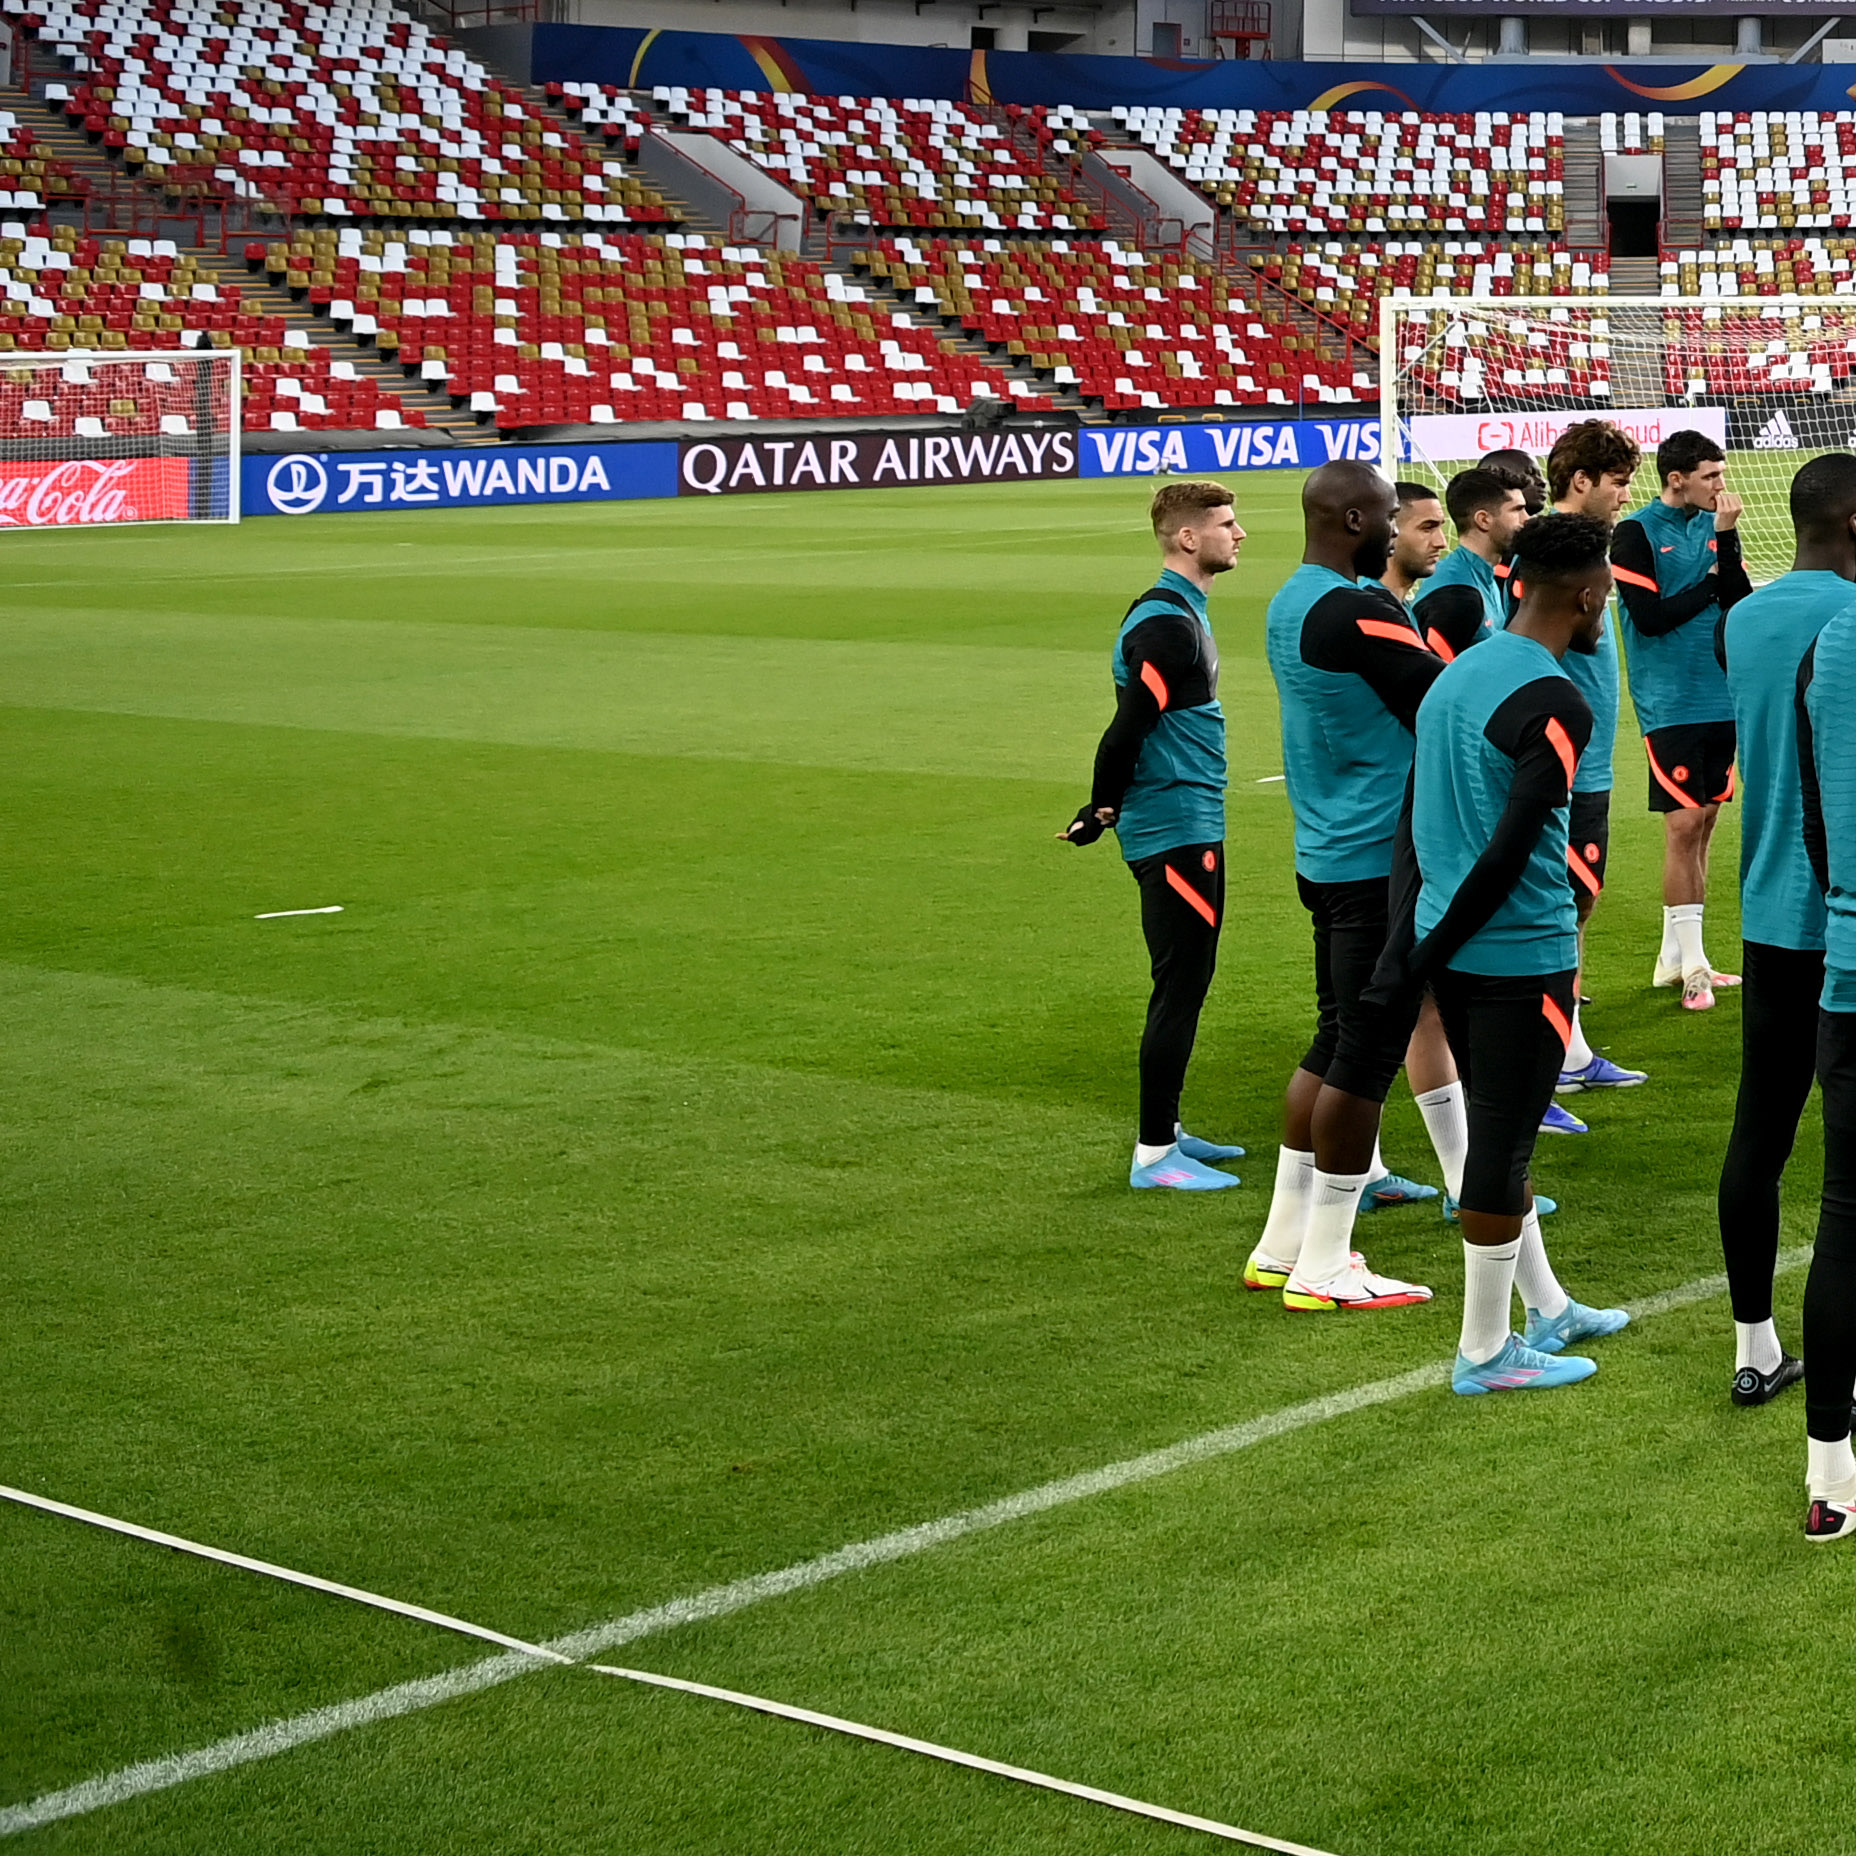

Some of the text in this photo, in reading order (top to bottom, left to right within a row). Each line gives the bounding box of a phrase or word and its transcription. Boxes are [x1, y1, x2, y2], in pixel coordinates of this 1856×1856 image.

[682, 429, 1076, 493] QATAR AIRWAYS
[1087, 430, 1190, 474] VISA
[1204, 424, 1300, 468] VISA
[1753, 434, 1799, 448] adidas
